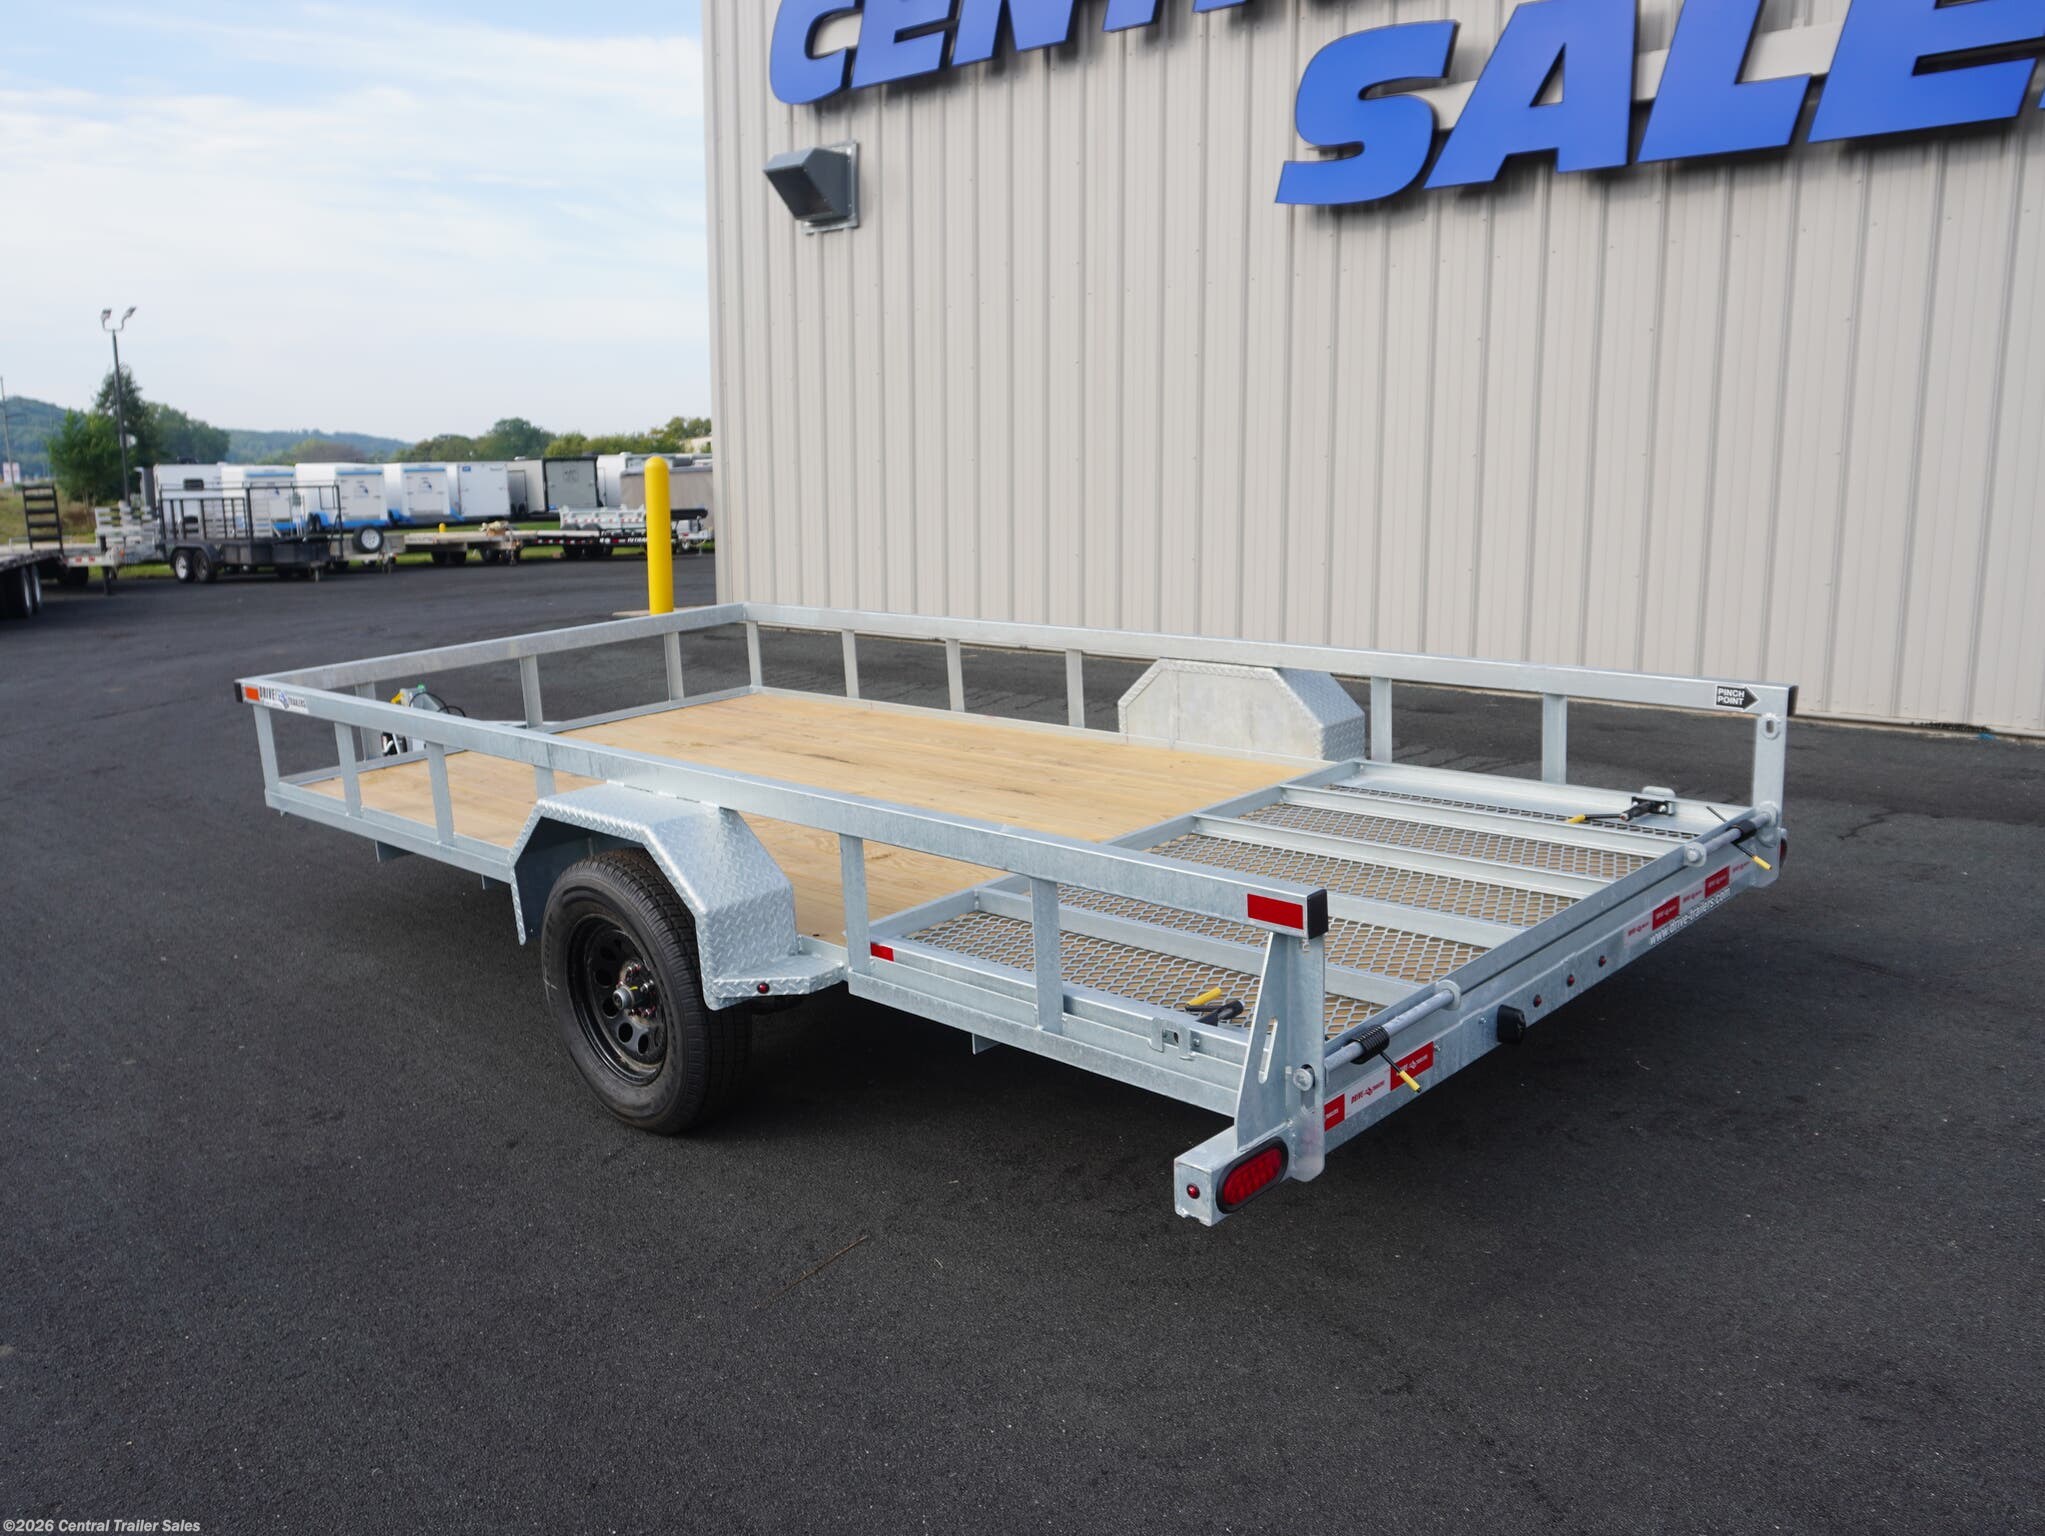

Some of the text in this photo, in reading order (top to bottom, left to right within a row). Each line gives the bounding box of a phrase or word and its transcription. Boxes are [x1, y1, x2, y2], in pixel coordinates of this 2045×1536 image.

[1275, 0, 2045, 205] SALE
[1718, 688, 1745, 698] PINCH
[1717, 696, 1744, 705] POINT
